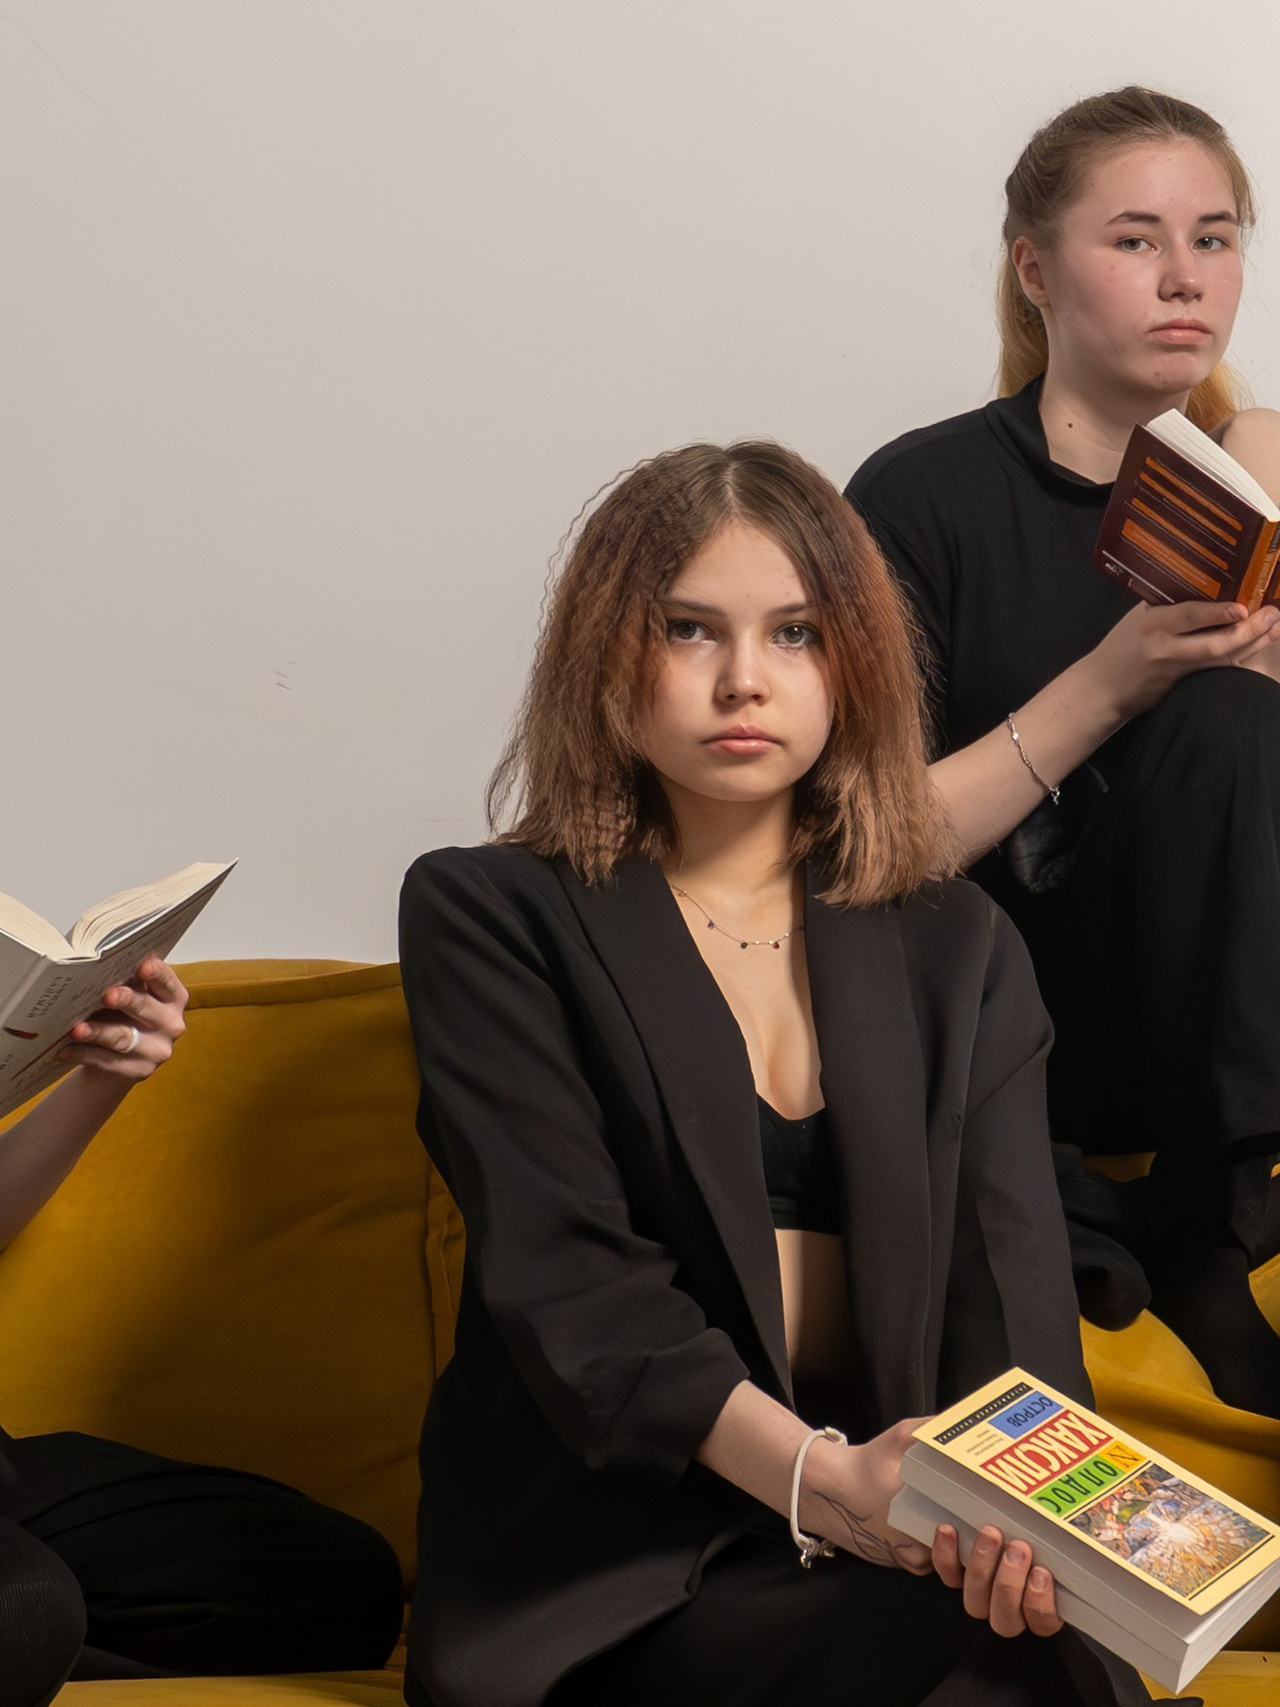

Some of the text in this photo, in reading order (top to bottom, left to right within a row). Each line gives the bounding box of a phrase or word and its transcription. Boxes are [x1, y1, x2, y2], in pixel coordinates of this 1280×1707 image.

[1006, 1396, 1053, 1427] ОСТРОВ
[986, 1412, 1108, 1492] ХАКСЛИ
[1037, 1460, 1118, 1512] ОЛДОС
